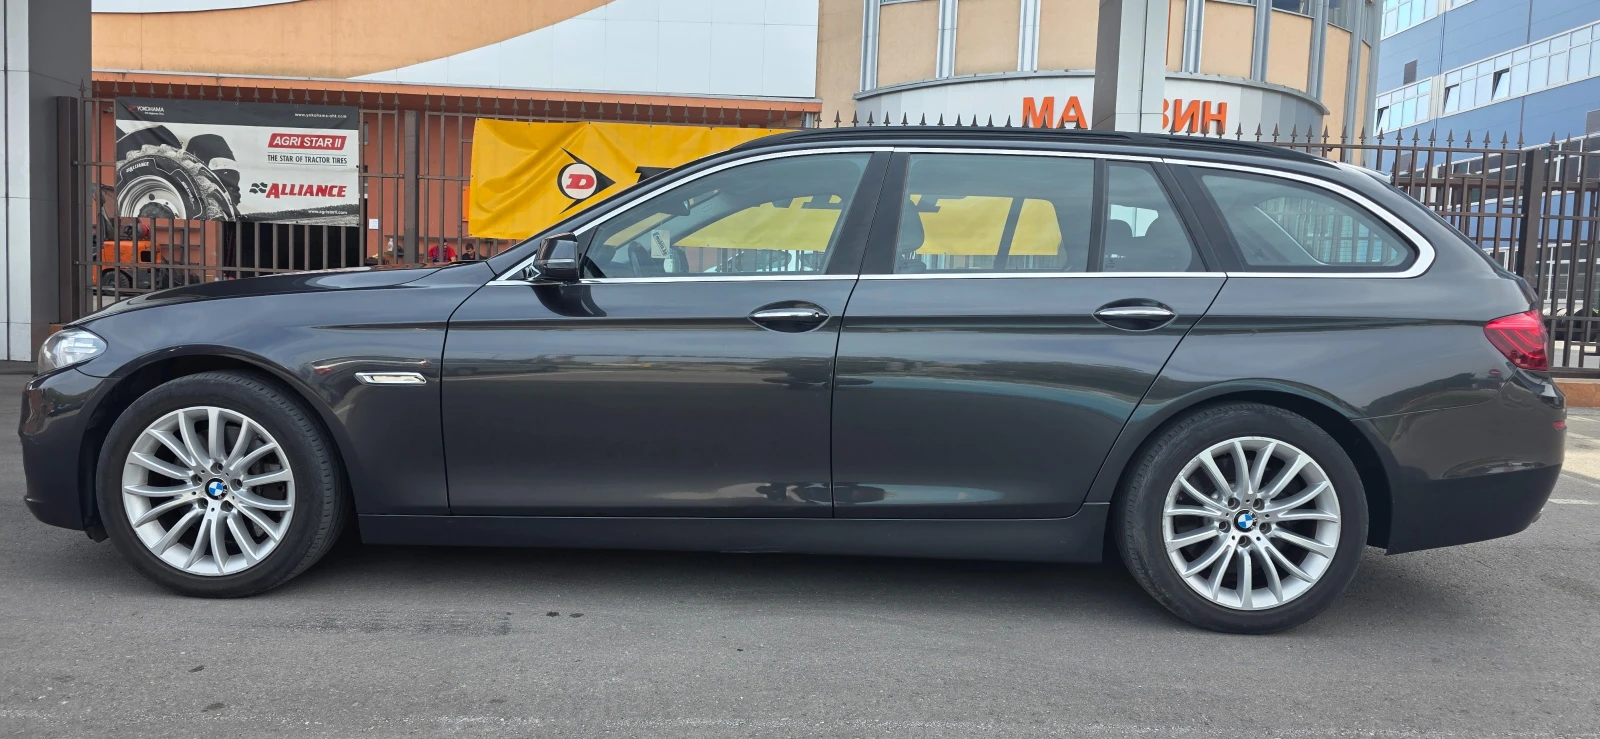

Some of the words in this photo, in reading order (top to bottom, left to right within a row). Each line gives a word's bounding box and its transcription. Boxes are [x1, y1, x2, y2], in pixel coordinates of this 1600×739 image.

[273, 136, 301, 146] AGRI
[303, 137, 333, 147] STAR
[334, 138, 342, 148] II
[267, 154, 278, 162] THE
[295, 155, 303, 163] OF
[305, 156, 331, 164] TRACTOR
[332, 157, 348, 165] TIRES
[565, 173, 596, 190] D
[265, 182, 348, 199] ALLIANCE
